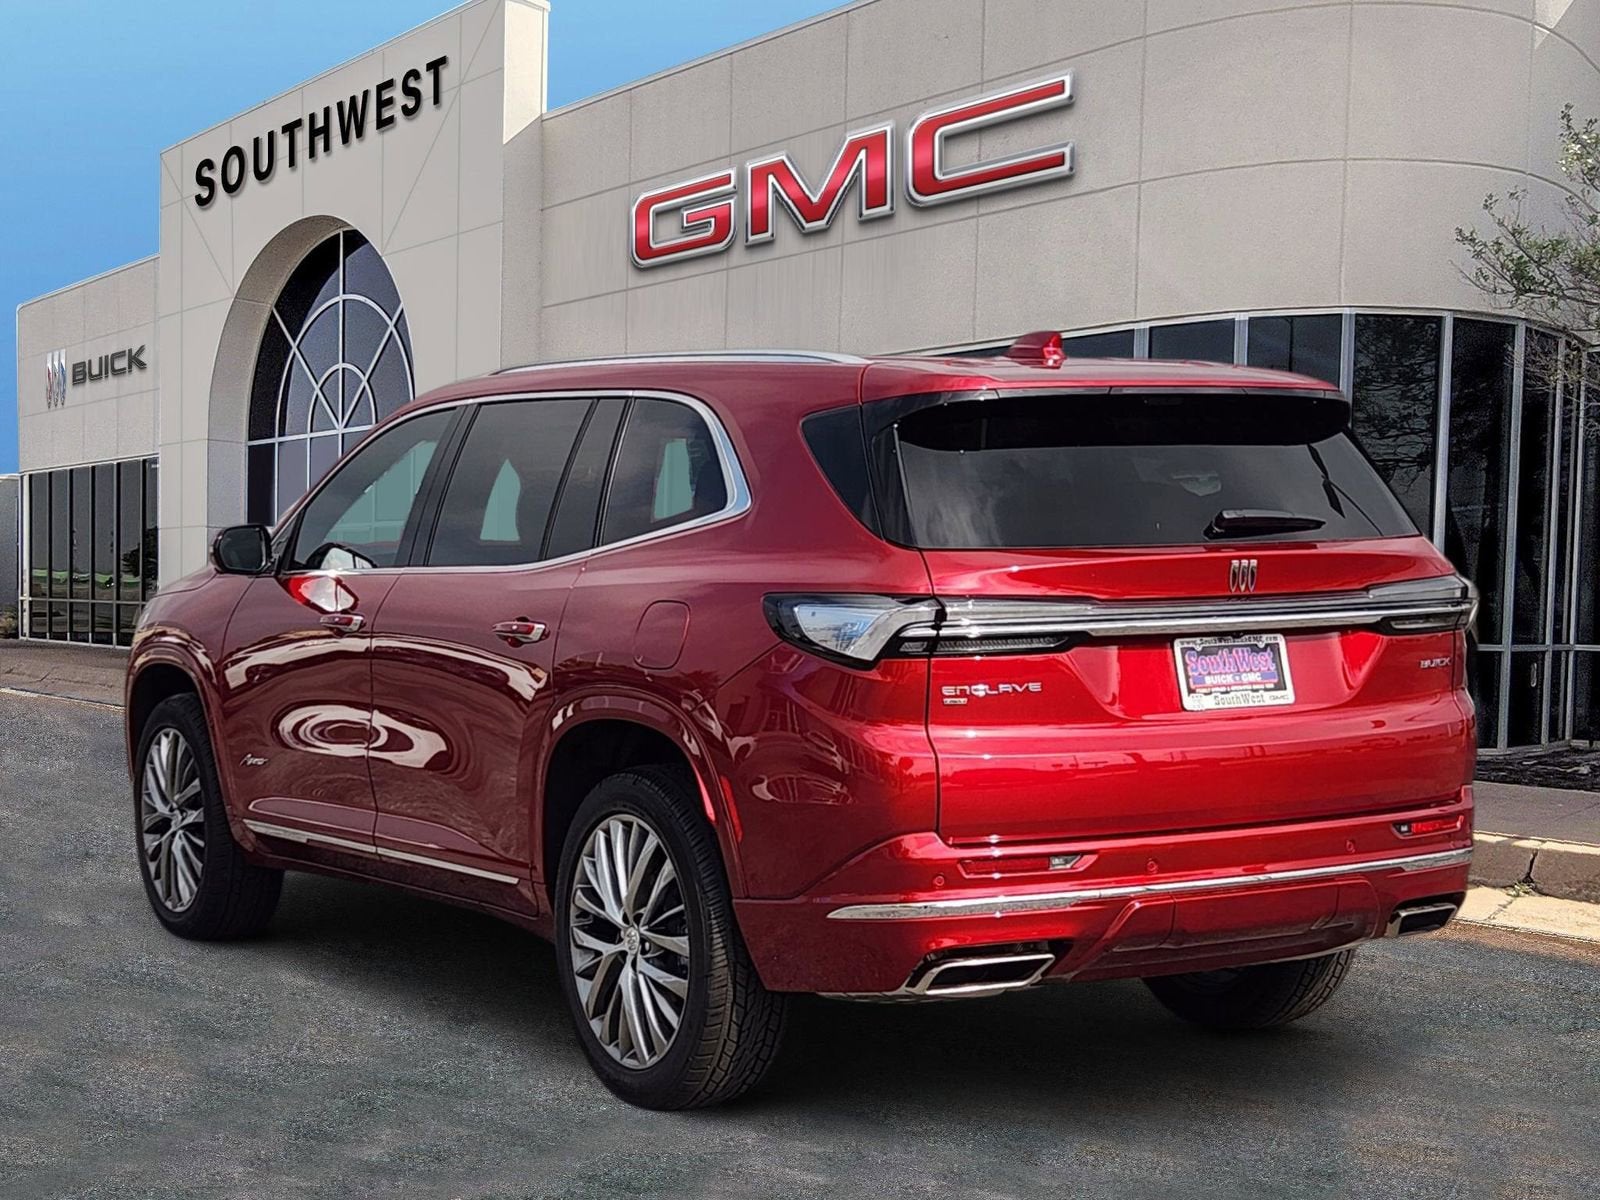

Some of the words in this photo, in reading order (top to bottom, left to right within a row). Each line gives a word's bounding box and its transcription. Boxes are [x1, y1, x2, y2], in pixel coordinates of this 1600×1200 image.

[194, 55, 449, 207] SOUTHWEST
[630, 69, 1075, 268] GMC
[72, 344, 147, 386] BUICK
[1185, 647, 1276, 676] SouthWest
[1420, 656, 1451, 669] BUICK
[1204, 674, 1233, 684] BUICK
[1241, 672, 1262, 681] GMC
[1213, 694, 1266, 706] SouthWest
